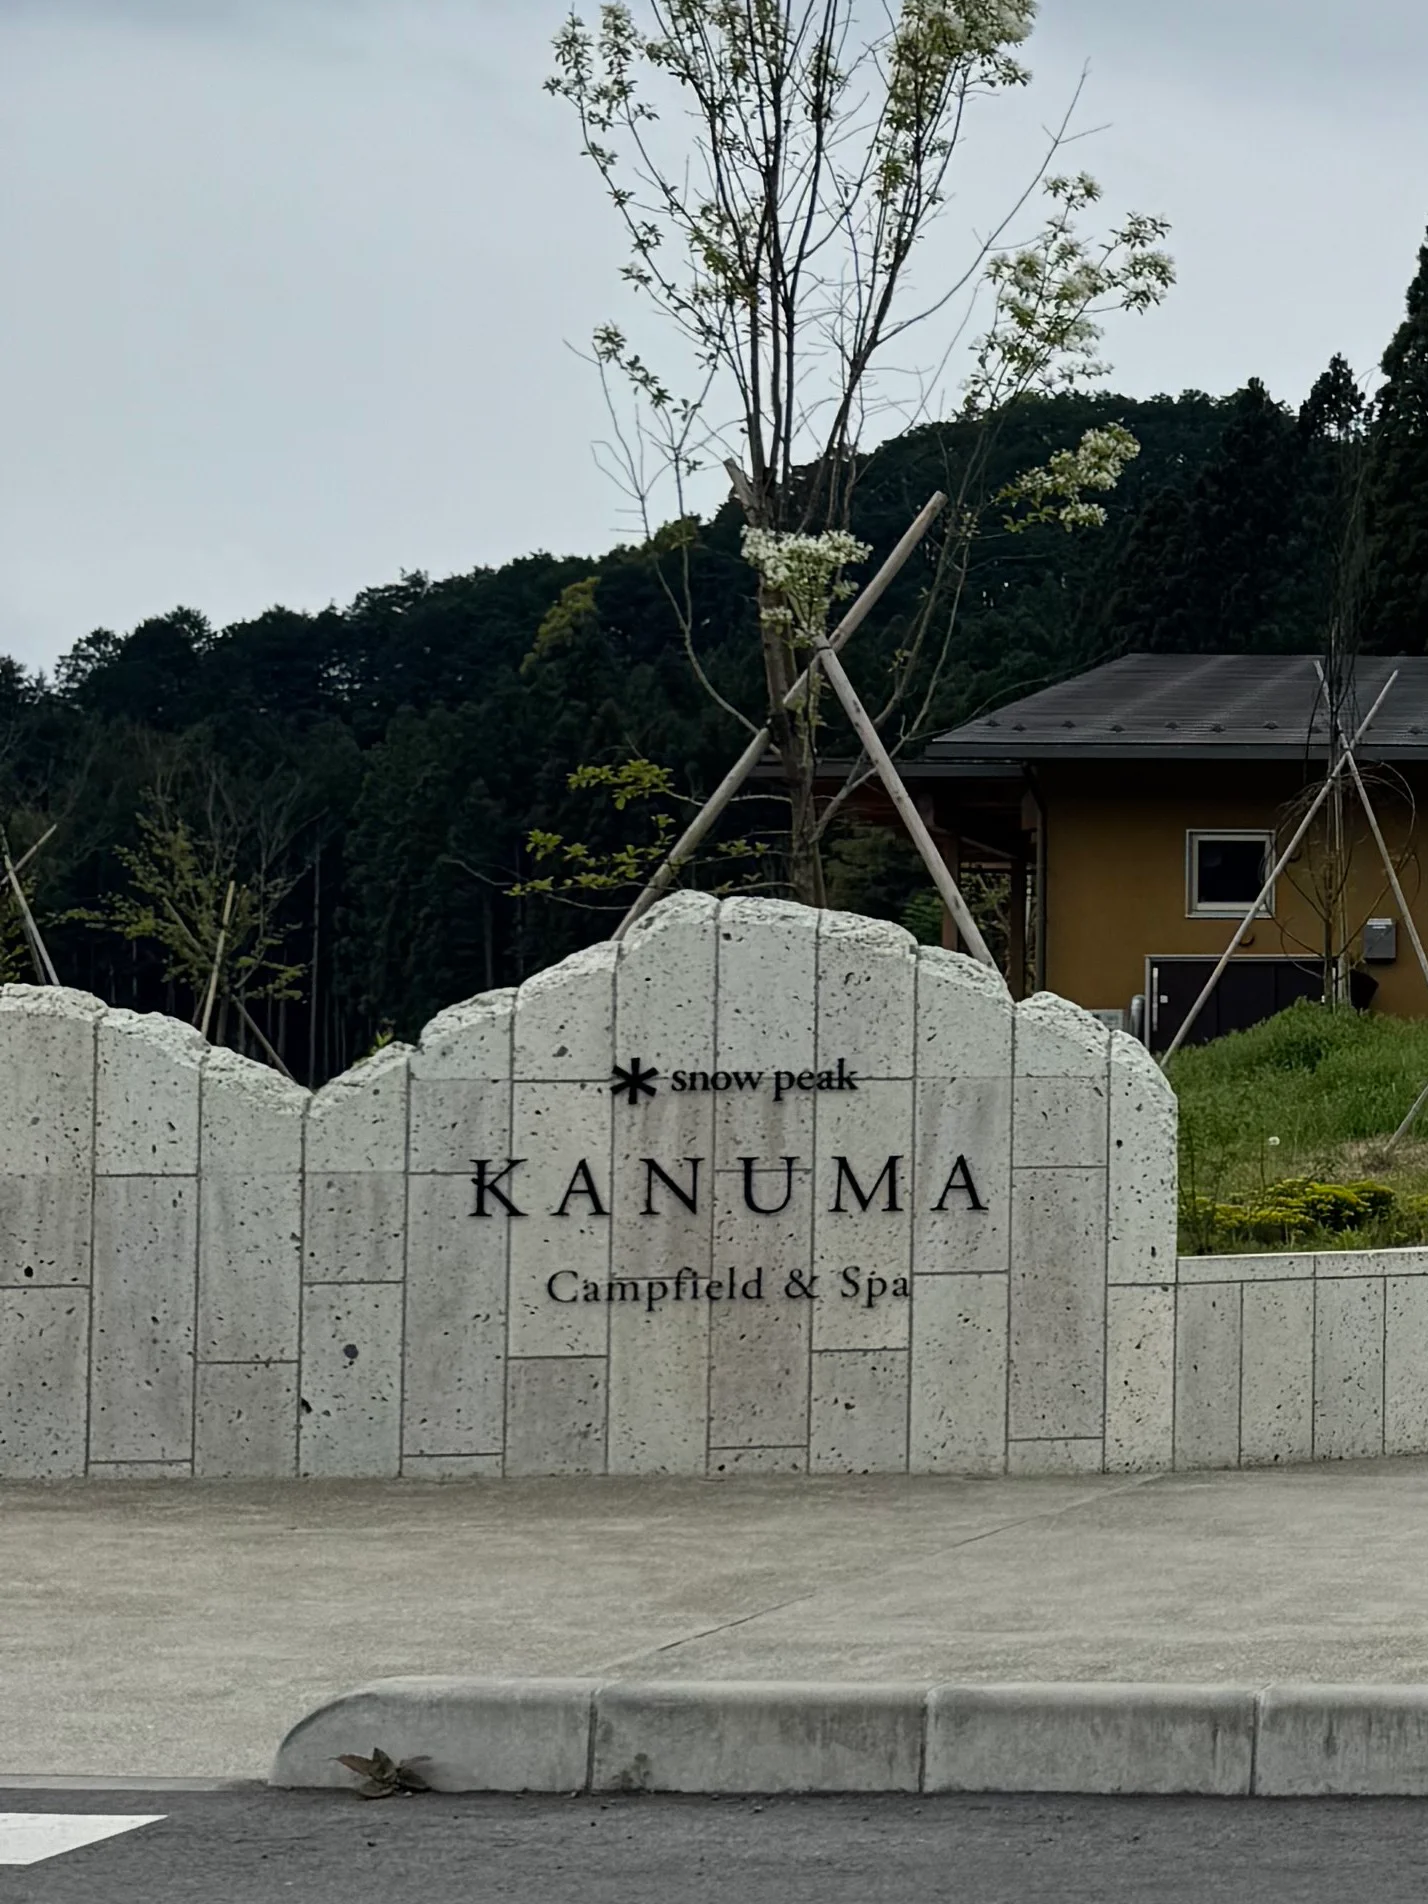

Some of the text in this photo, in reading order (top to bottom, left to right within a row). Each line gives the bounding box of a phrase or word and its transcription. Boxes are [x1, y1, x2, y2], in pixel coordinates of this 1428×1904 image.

[671, 1057, 859, 1100] snow peak
[468, 1154, 990, 1218] KANUMA
[547, 1265, 912, 1312] Campfield & Spa
